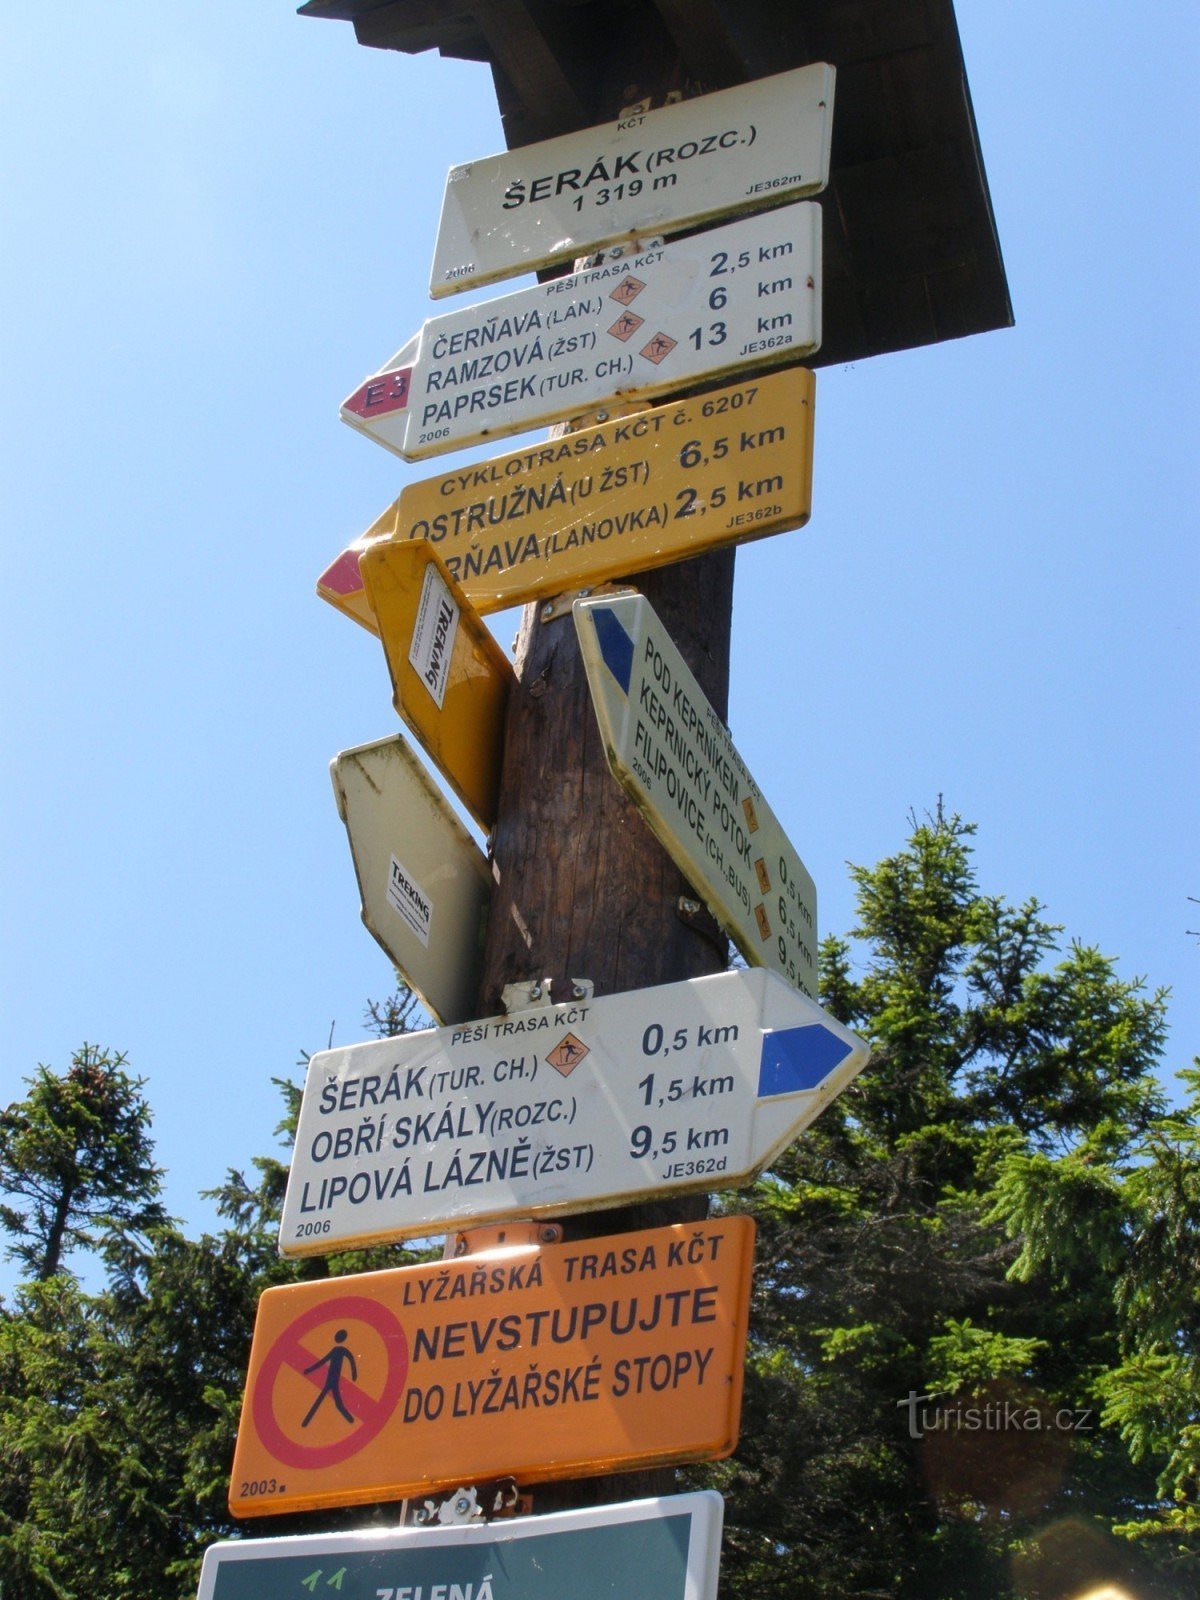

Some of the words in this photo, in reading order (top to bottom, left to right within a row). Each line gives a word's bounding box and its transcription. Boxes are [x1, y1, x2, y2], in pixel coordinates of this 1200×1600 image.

[617, 115, 646, 131] KČT
[653, 173, 677, 191] m
[745, 174, 802, 195] JE362m
[445, 263, 475, 281] 2006
[546, 276, 578, 296] PĚŠÍ
[583, 262, 631, 286] TRASA
[634, 251, 665, 269] KČT
[709, 251, 750, 278] 2,5
[758, 242, 793, 263] km
[708, 286, 728, 311] 6
[757, 277, 793, 298] km
[595, 354, 633, 378] CH.)
[688, 321, 728, 351] 13
[757, 313, 792, 334] km
[739, 334, 793, 356] JE362a
[418, 427, 450, 444] 2006
[440, 433, 607, 497] CYKLOTRASA
[614, 414, 667, 443] KČT
[672, 409, 693, 426] č.
[701, 387, 760, 418] 6207
[599, 460, 650, 493] ŽST)
[678, 437, 730, 469] 6,5
[740, 425, 785, 453] km
[673, 486, 727, 520] 2,5
[737, 474, 784, 502] km
[726, 504, 783, 529] JE362b
[631, 756, 652, 790] 2006
[644, 636, 671, 695] POD
[673, 681, 739, 806] KEPRNÍKEM
[779, 856, 796, 900] 0,5
[797, 892, 812, 929] km
[640, 677, 711, 802] KEPRNICKÝ
[713, 789, 752, 871] POTOK
[778, 896, 796, 940] 6,5
[797, 931, 813, 968] km
[778, 935, 796, 980] 9,5
[451, 1024, 489, 1046] PĚŠÍ
[493, 1015, 549, 1038] TRASA
[554, 1007, 590, 1026] KČT
[493, 1054, 538, 1083] CH.)
[642, 1023, 688, 1057] 0,5
[697, 1024, 739, 1047] km
[310, 1113, 388, 1163] OBŘÍ
[638, 1073, 683, 1109] 1,5
[692, 1075, 734, 1098] km
[300, 1157, 413, 1213] LIPOVÁ
[629, 1124, 677, 1160] 9,5
[687, 1127, 729, 1150] km
[662, 1156, 728, 1179] JE362d
[295, 1219, 332, 1238] 2006
[403, 1255, 543, 1306] LYŽAŘSKÁ
[563, 1245, 657, 1283] TRASA
[666, 1231, 725, 1268] KČT
[412, 1285, 719, 1363] NEVSTUPUJTE
[403, 1384, 445, 1424] DO
[452, 1354, 602, 1418] LYŽAŘSKÉ
[611, 1347, 715, 1397] STOPY
